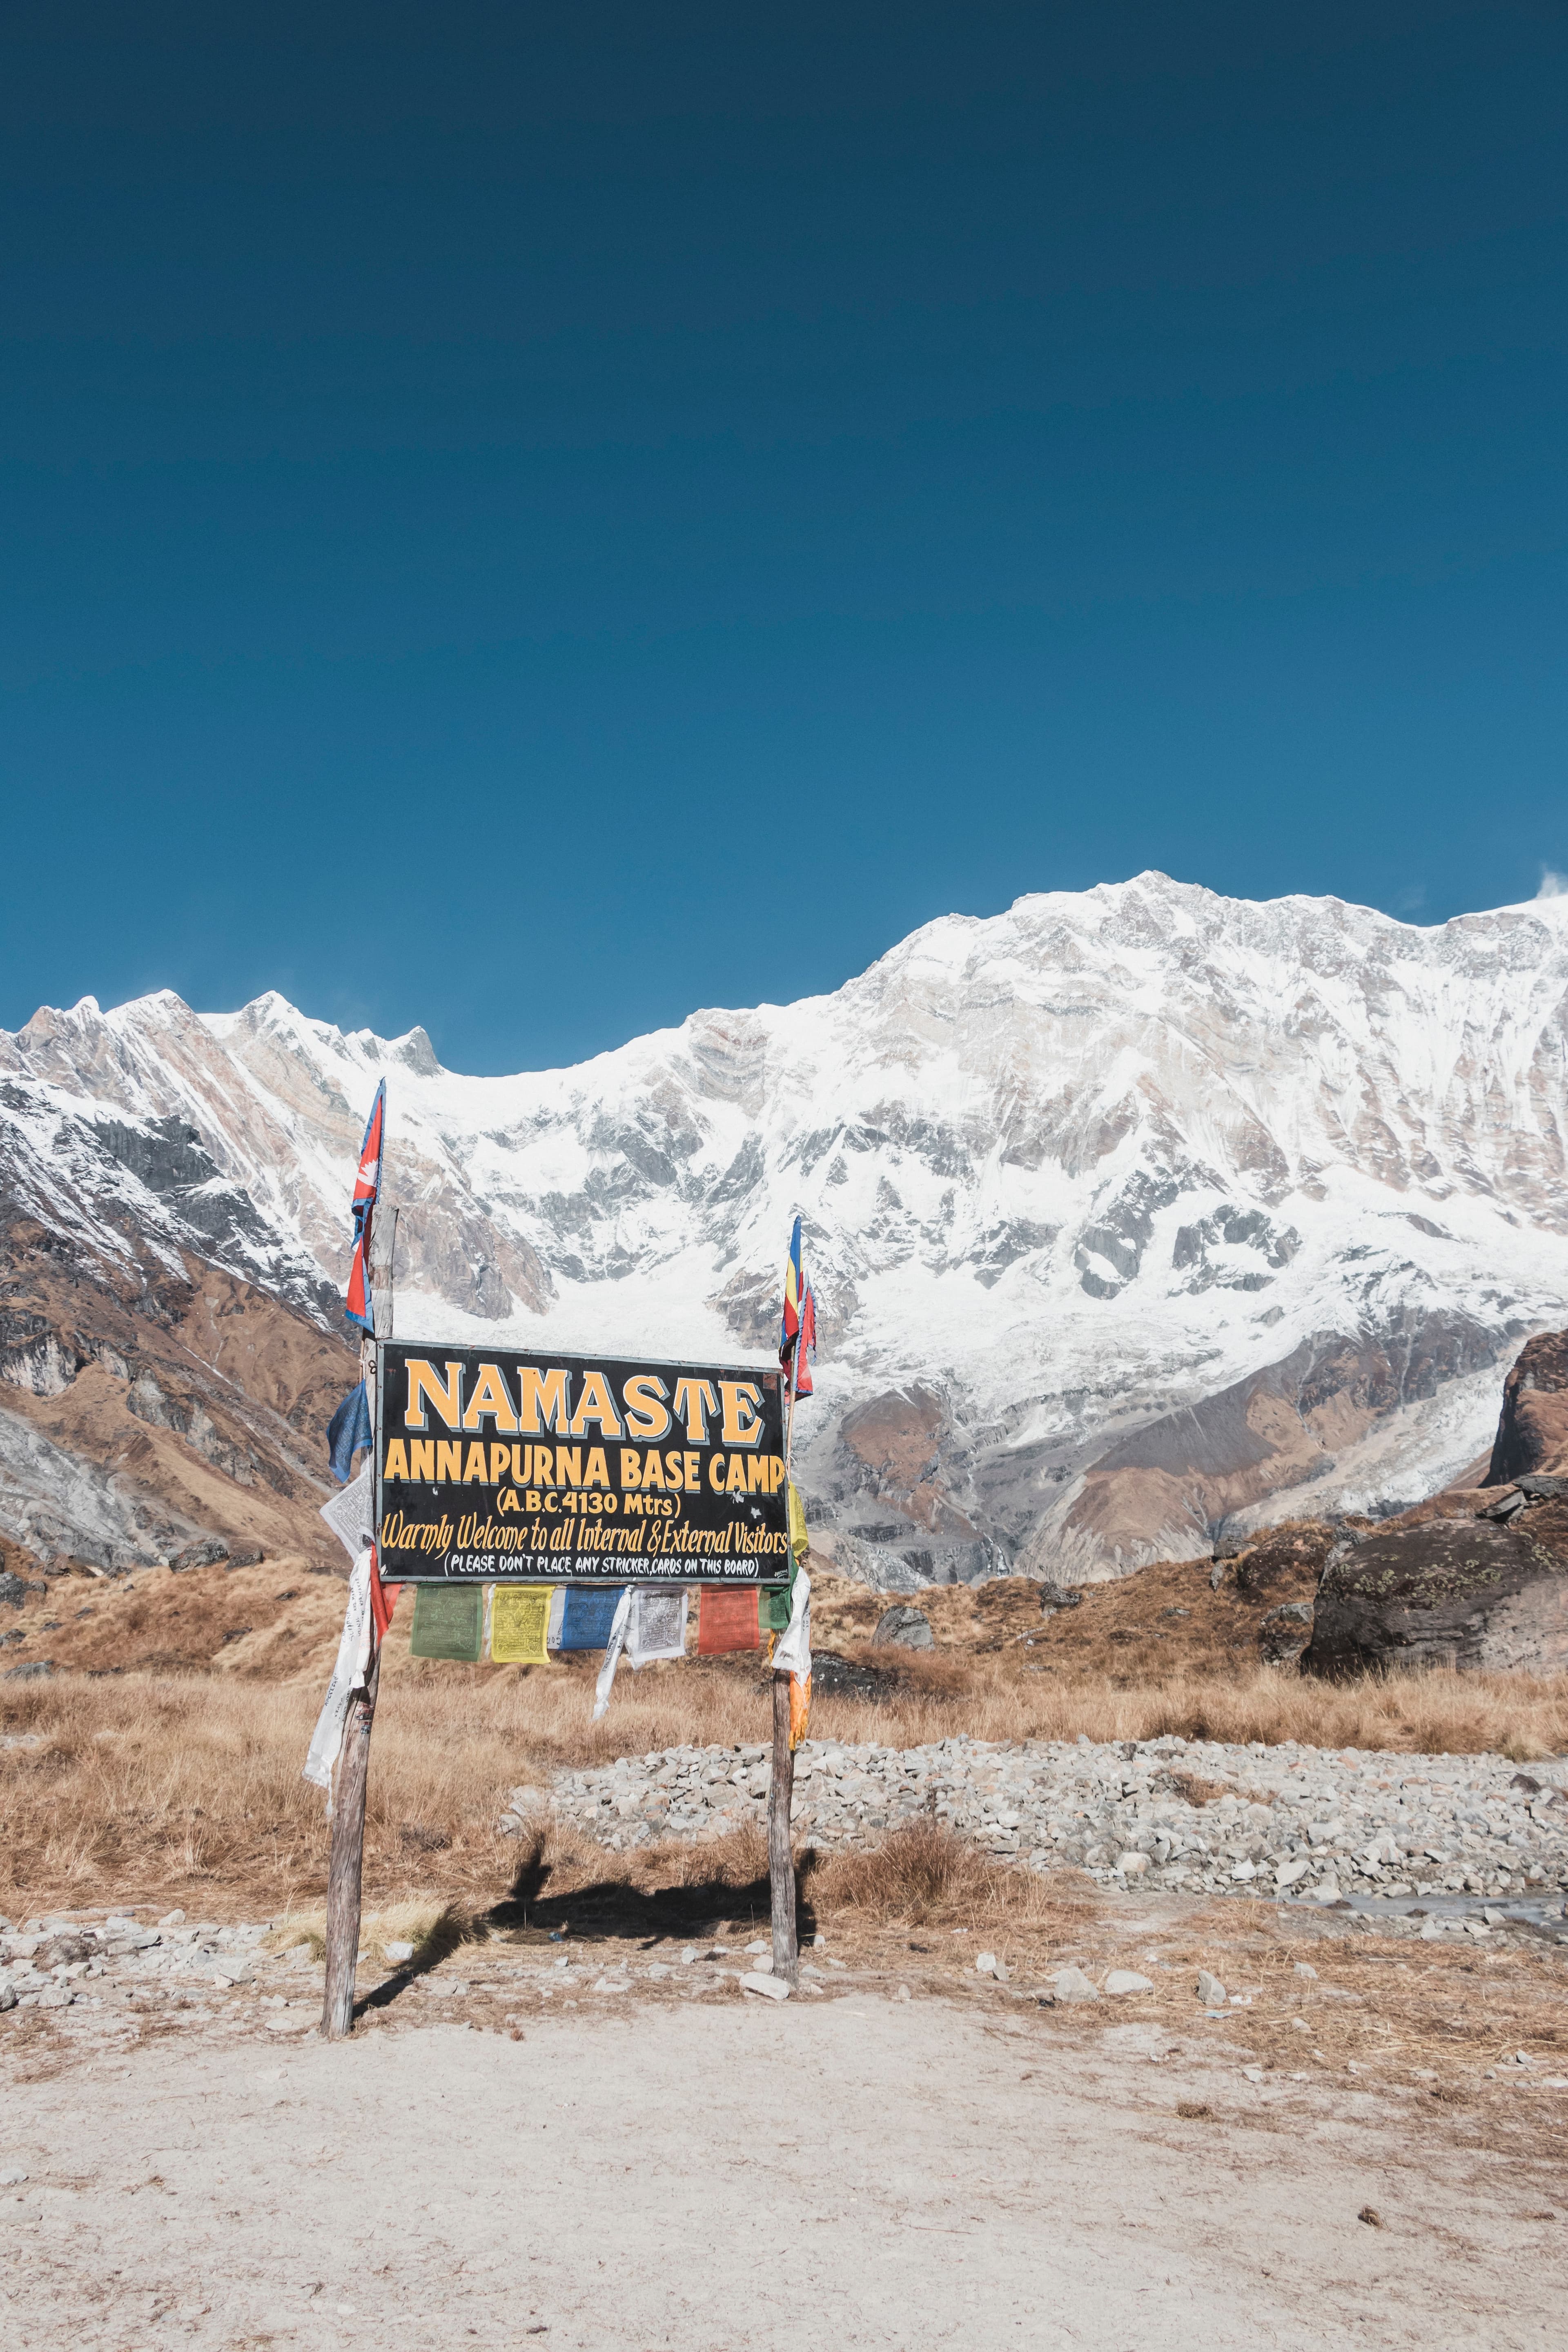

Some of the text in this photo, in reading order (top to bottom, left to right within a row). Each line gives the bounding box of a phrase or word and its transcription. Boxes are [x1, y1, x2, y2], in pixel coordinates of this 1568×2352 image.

[405, 1359, 765, 1448] NAMASTE
[383, 1438, 785, 1496] ANNAPURNA BASE CAMP
[624, 1493, 681, 1519] Mtrs)
[381, 1510, 454, 1559] Warmly
[457, 1511, 528, 1554] Welcome
[531, 1517, 547, 1551] to
[550, 1517, 575, 1551] all
[577, 1518, 646, 1552] Internal
[735, 1521, 787, 1554] Visitors
[444, 1552, 495, 1576] (PLEASE
[499, 1554, 534, 1572] DON'T
[537, 1556, 572, 1574] PLACE
[575, 1557, 600, 1572] ANY
[685, 1557, 697, 1573] ON
[699, 1558, 720, 1574] THIS
[724, 1557, 759, 1577] BOARD)
